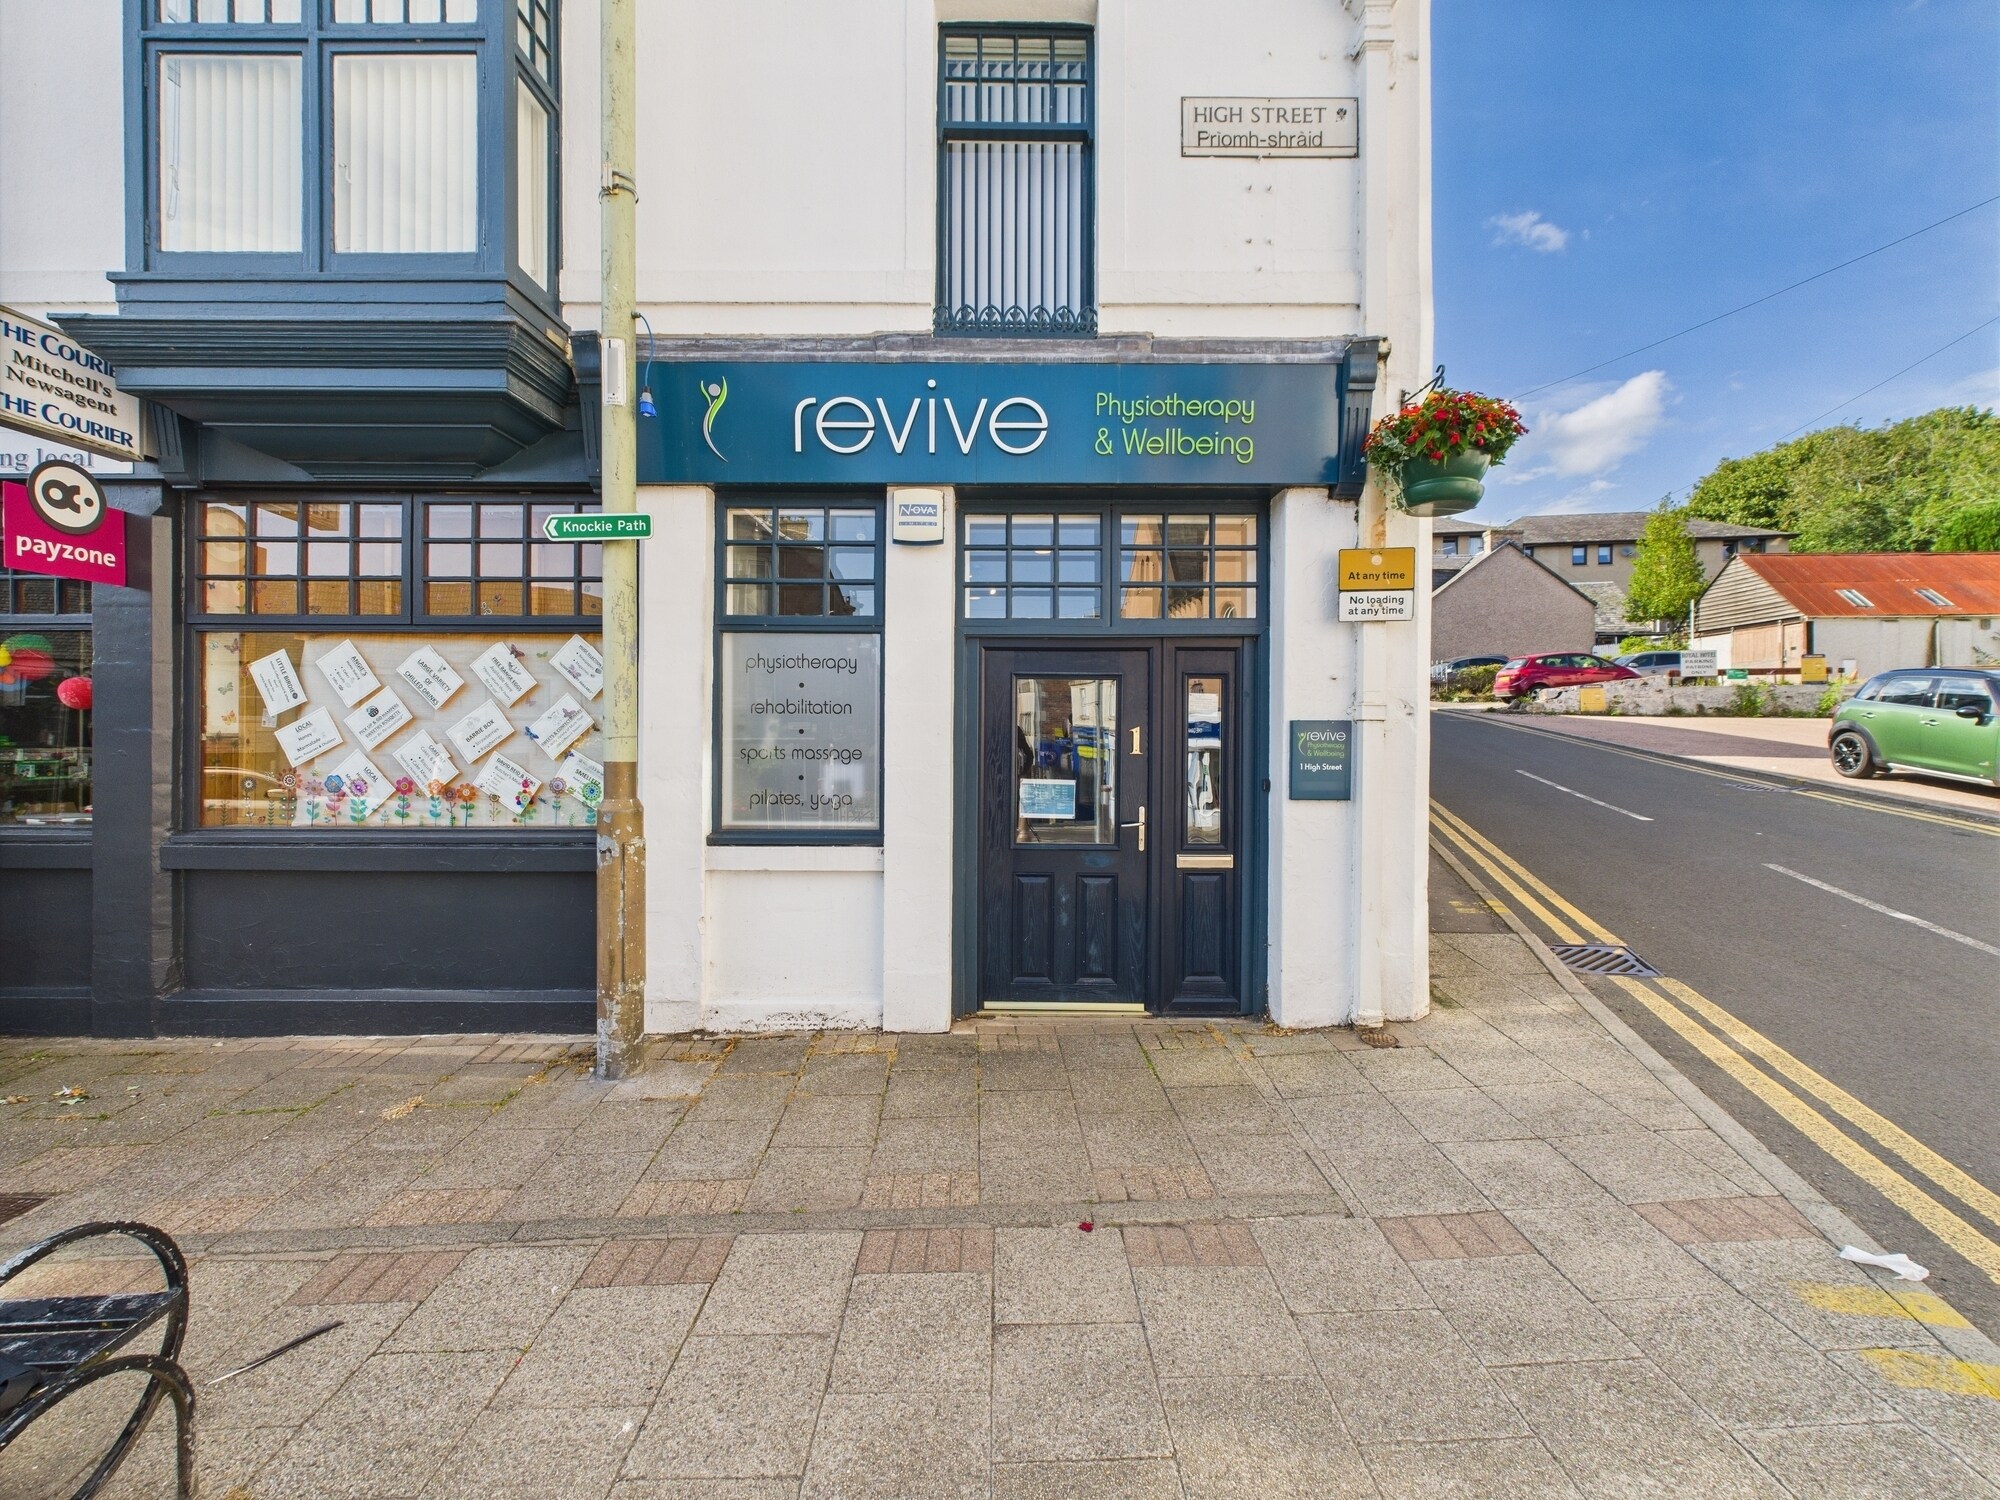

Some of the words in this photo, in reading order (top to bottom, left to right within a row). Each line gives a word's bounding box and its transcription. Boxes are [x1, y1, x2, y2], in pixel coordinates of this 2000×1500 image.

[1194, 106, 1243, 123] HIGH
[1251, 106, 1327, 123] STREET
[11, 348, 113, 399] Mitchell's
[5, 365, 118, 417] Newsagent
[794, 379, 1049, 455] revive
[1096, 392, 1255, 424] Physiotherapy
[41, 403, 134, 449] COURIER
[1095, 427, 1113, 455] &
[1122, 427, 1254, 464] Wellbeing
[563, 520, 613, 533] Knockie
[617, 520, 647, 531] Path
[15, 534, 116, 567] payzone
[1348, 571, 1360, 580] At
[1362, 573, 1380, 581] any
[1383, 571, 1405, 579] time
[1348, 607, 1358, 615] at
[1360, 608, 1379, 616] any
[1382, 606, 1404, 615] time
[1349, 596, 1364, 604] No
[1366, 595, 1404, 605] loading
[351, 654, 368, 676] ANGIE'S
[745, 653, 857, 674] physiotherapy
[275, 657, 286, 675] LITTLE
[283, 674, 295, 693] BIRDIE
[417, 658, 433, 673] LARGE
[432, 672, 451, 692] VARIETY
[424, 677, 432, 685] OF
[404, 670, 423, 689] CHILLED
[421, 687, 439, 705] DRINKS
[750, 698, 852, 715] rehabilitation
[294, 720, 312, 732] LOCAL
[465, 726, 483, 742] BARRIE
[483, 718, 494, 729] BOX
[1307, 729, 1346, 741] revive
[1128, 726, 1144, 755] 1
[740, 745, 786, 764] sports
[791, 748, 862, 765] massage
[364, 765, 379, 782] LOCAL
[1304, 763, 1320, 772] High
[749, 789, 804, 810] pilates,
[810, 794, 853, 811] yoga
